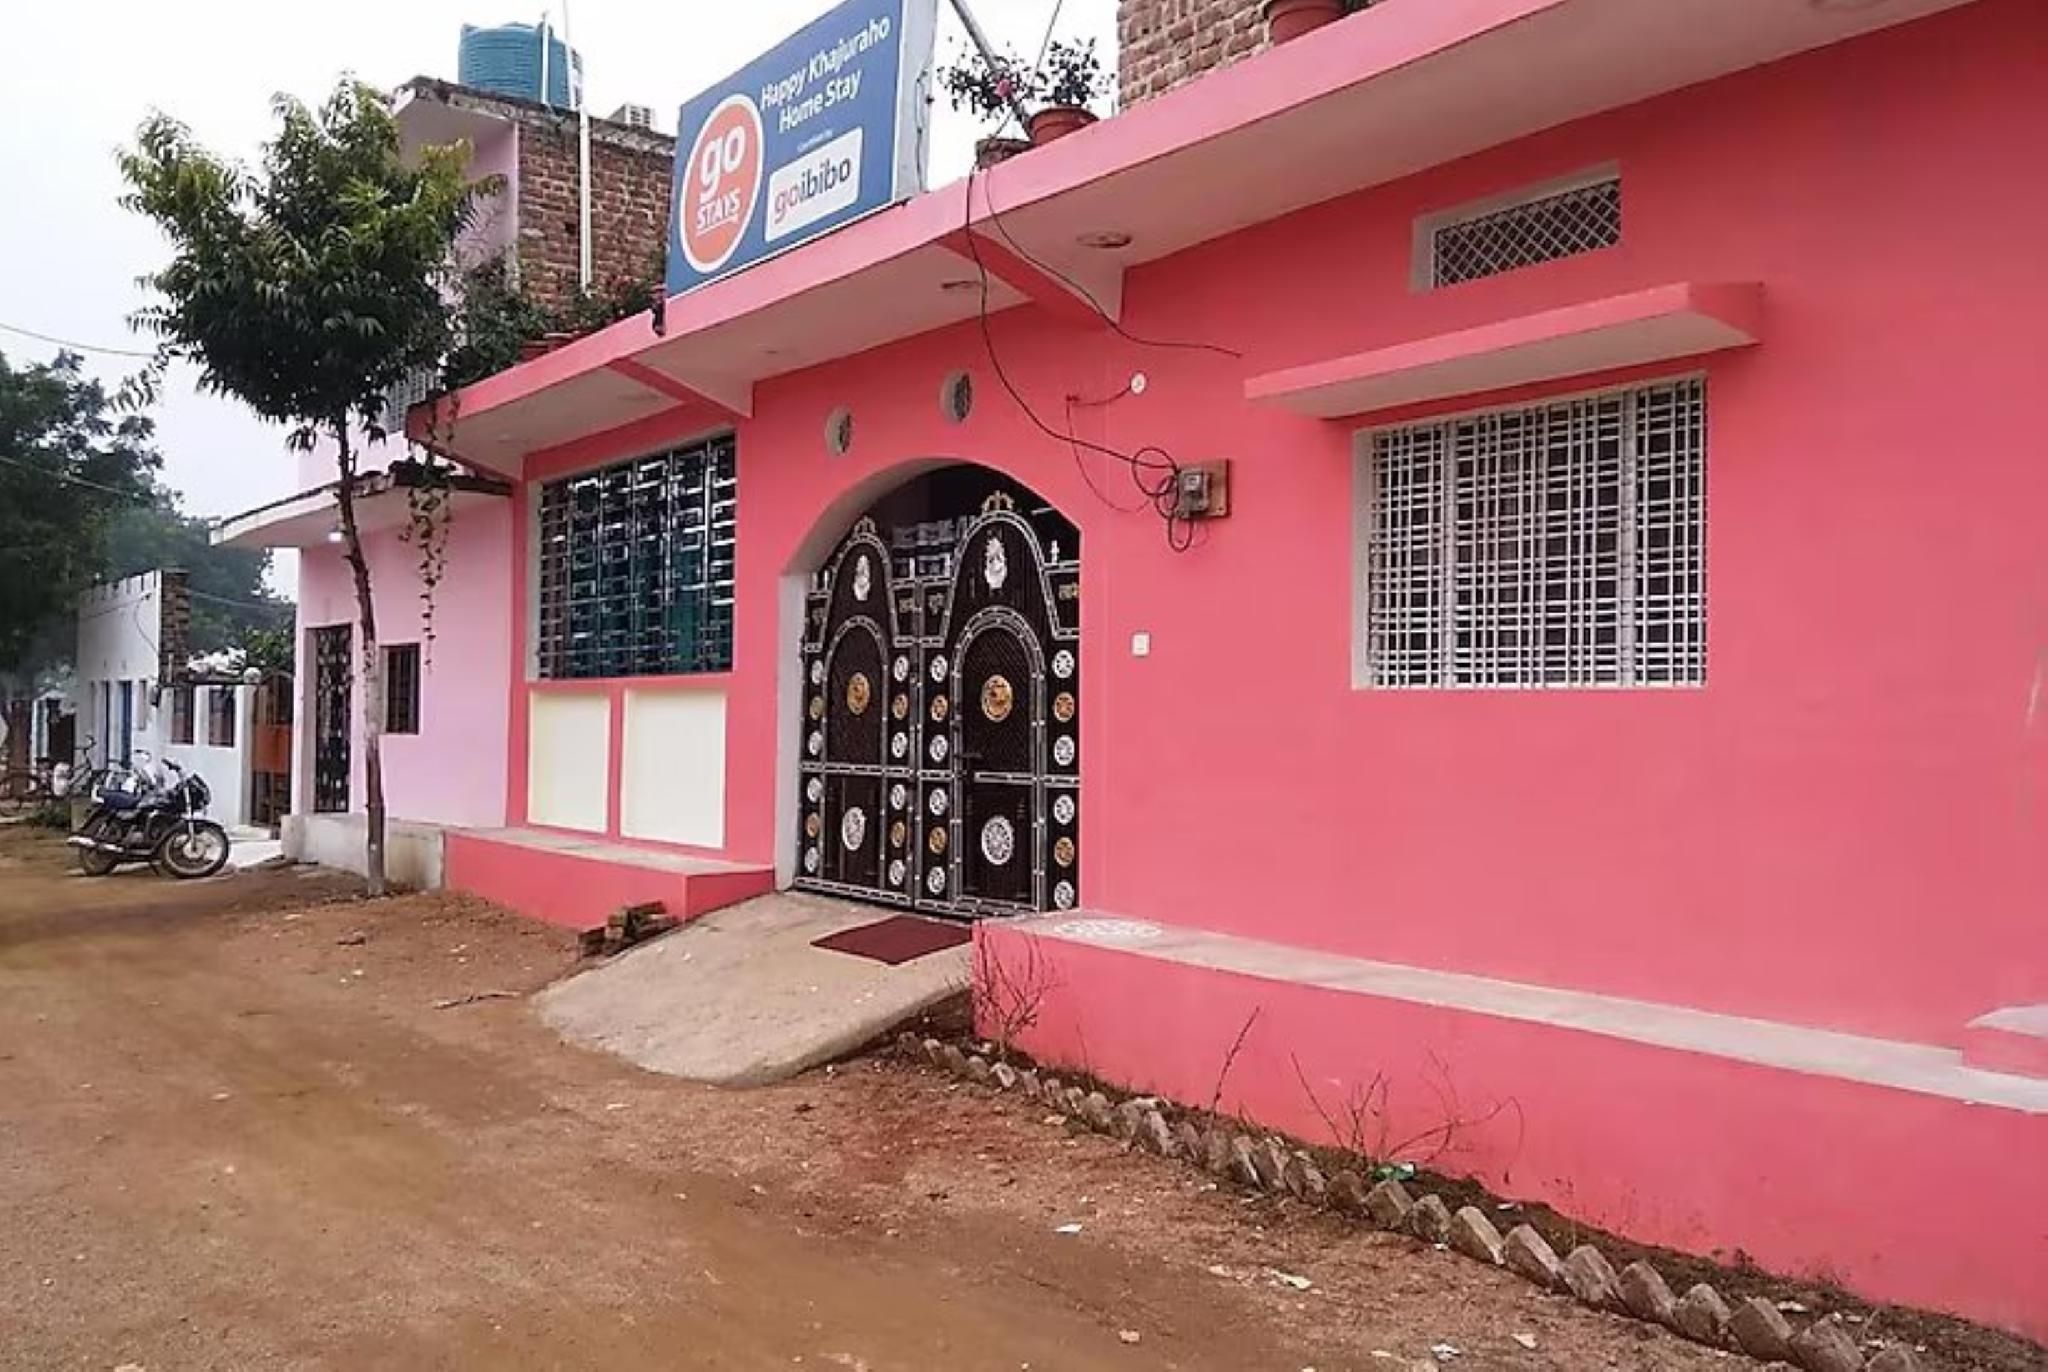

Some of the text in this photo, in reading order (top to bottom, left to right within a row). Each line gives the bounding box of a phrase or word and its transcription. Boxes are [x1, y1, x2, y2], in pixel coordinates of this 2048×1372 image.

[760, 16, 891, 111] Happy Khajuraho
[778, 69, 862, 134] Home Stay
[700, 125, 746, 204] go
[773, 157, 851, 225] goibibo
[696, 188, 741, 230] STAYS
